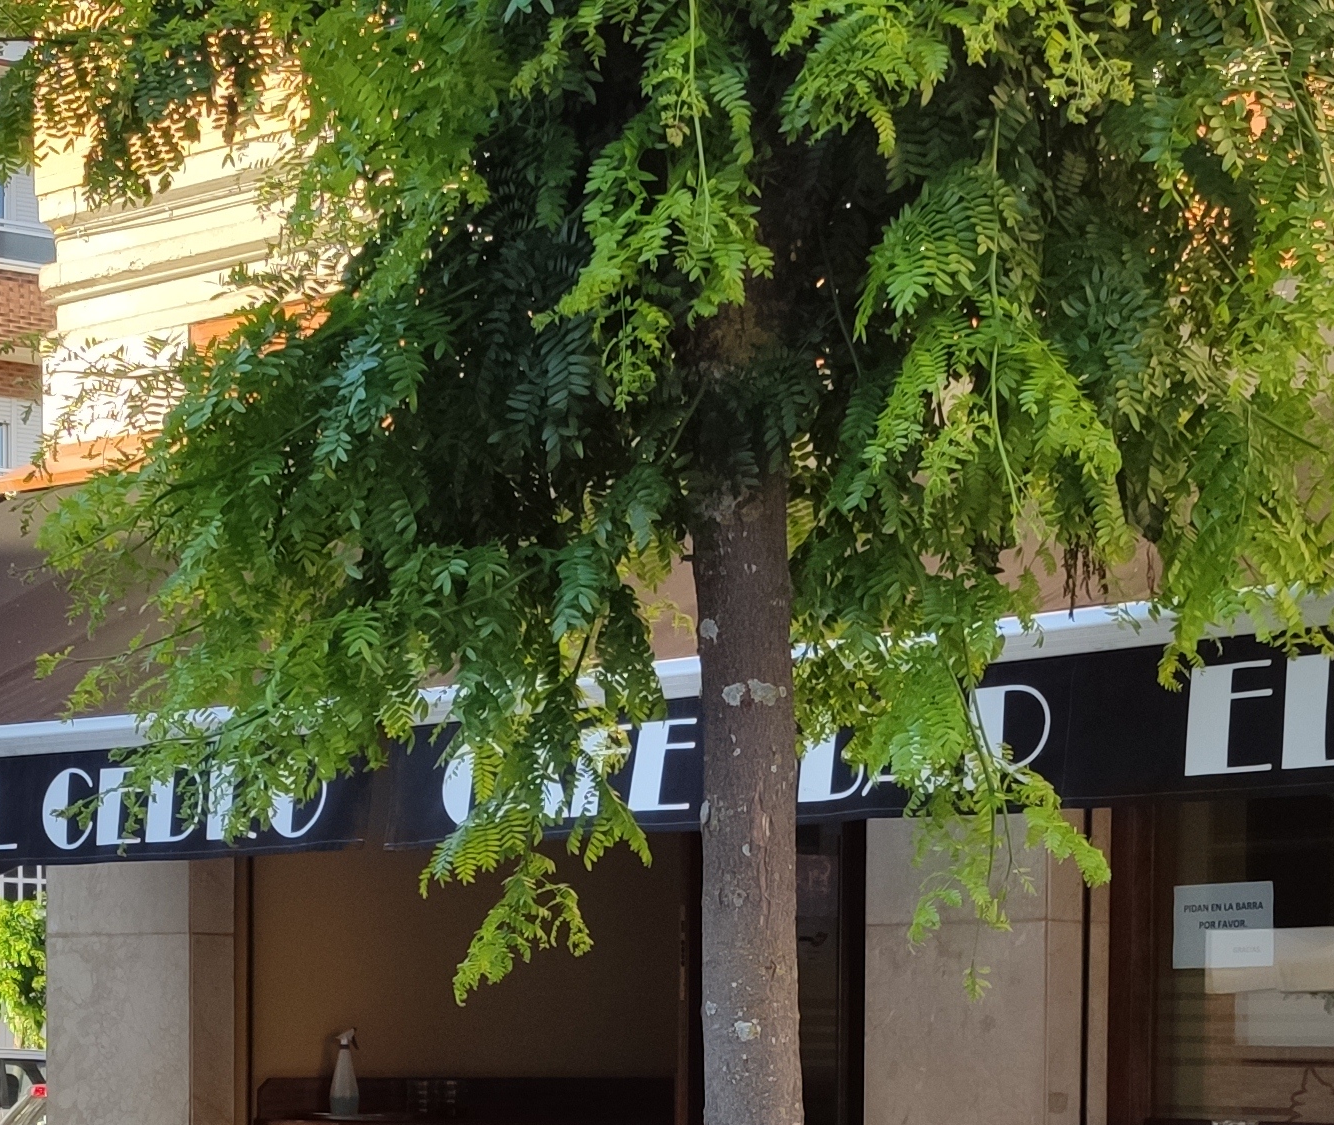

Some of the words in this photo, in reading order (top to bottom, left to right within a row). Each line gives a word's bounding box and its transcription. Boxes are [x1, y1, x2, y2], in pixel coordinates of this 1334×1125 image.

[1184, 904, 1208, 913] PIDAN
[1211, 903, 1222, 912] EN
[1224, 903, 1234, 911] LA
[1236, 901, 1264, 911] BARRA
[1199, 921, 1215, 929] POR
